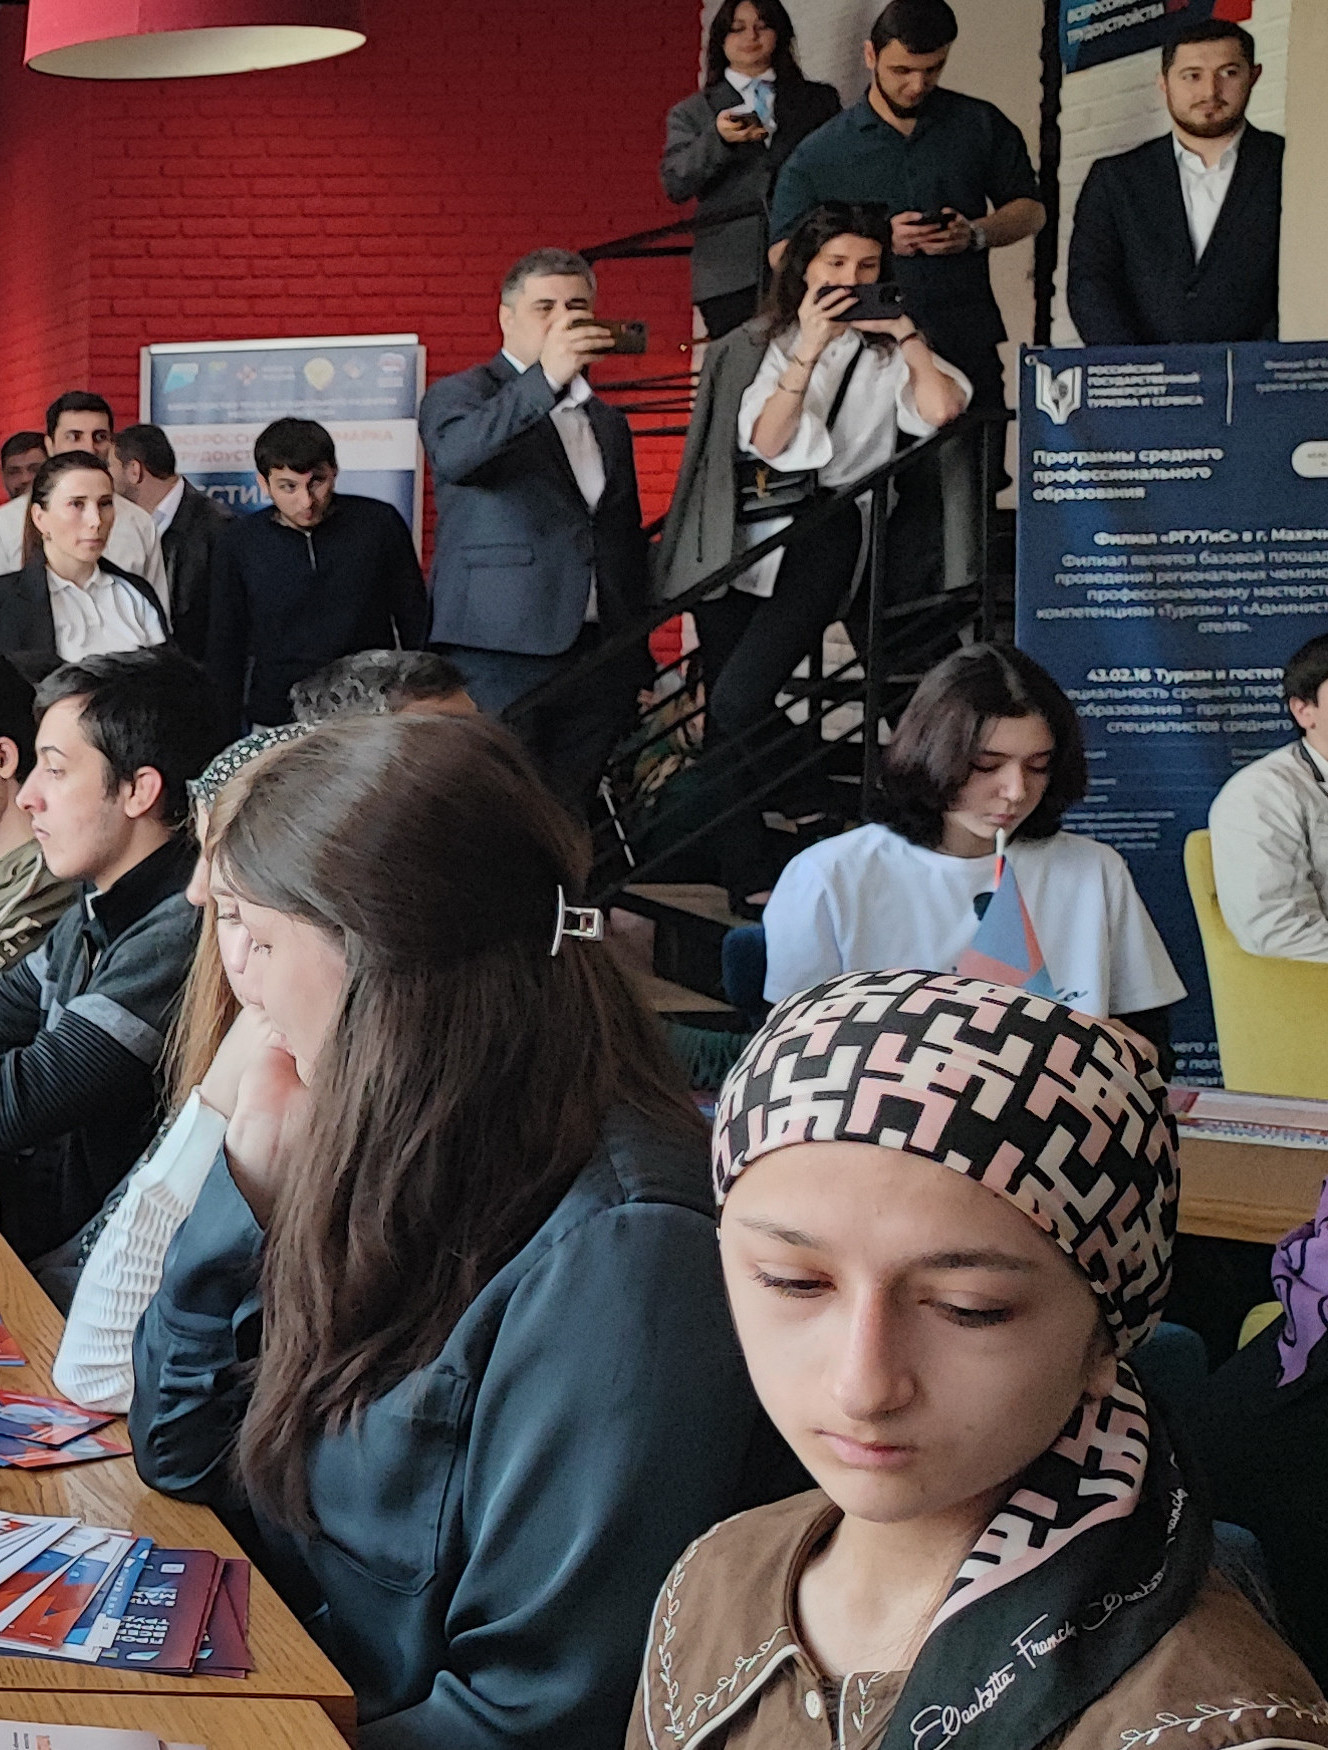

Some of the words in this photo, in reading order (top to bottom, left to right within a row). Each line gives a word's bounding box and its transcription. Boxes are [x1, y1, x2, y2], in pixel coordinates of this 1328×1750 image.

[1033, 450, 1136, 466] Программы
[1138, 448, 1224, 464] среднего
[1033, 467, 1213, 485] профессионального
[1033, 486, 1146, 503] образования
[1094, 531, 1158, 545] Филиал
[1271, 528, 1328, 541] Махачк
[1062, 553, 1127, 567] Филиал
[1199, 550, 1265, 564] базовой
[1269, 551, 1328, 563] площад
[1270, 568, 1328, 580] чемпио
[1253, 585, 1328, 599] мастерст
[1243, 602, 1328, 616] «Админист
[1154, 669, 1212, 685] Туризм
[1215, 669, 1226, 680] и
[1066, 687, 1170, 700] ециальность
[1172, 685, 1241, 700] среднего
[1244, 684, 1285, 698] проф
[1076, 702, 1183, 718] образования
[1197, 702, 1281, 717] программа
[1223, 719, 1293, 733] среднего
